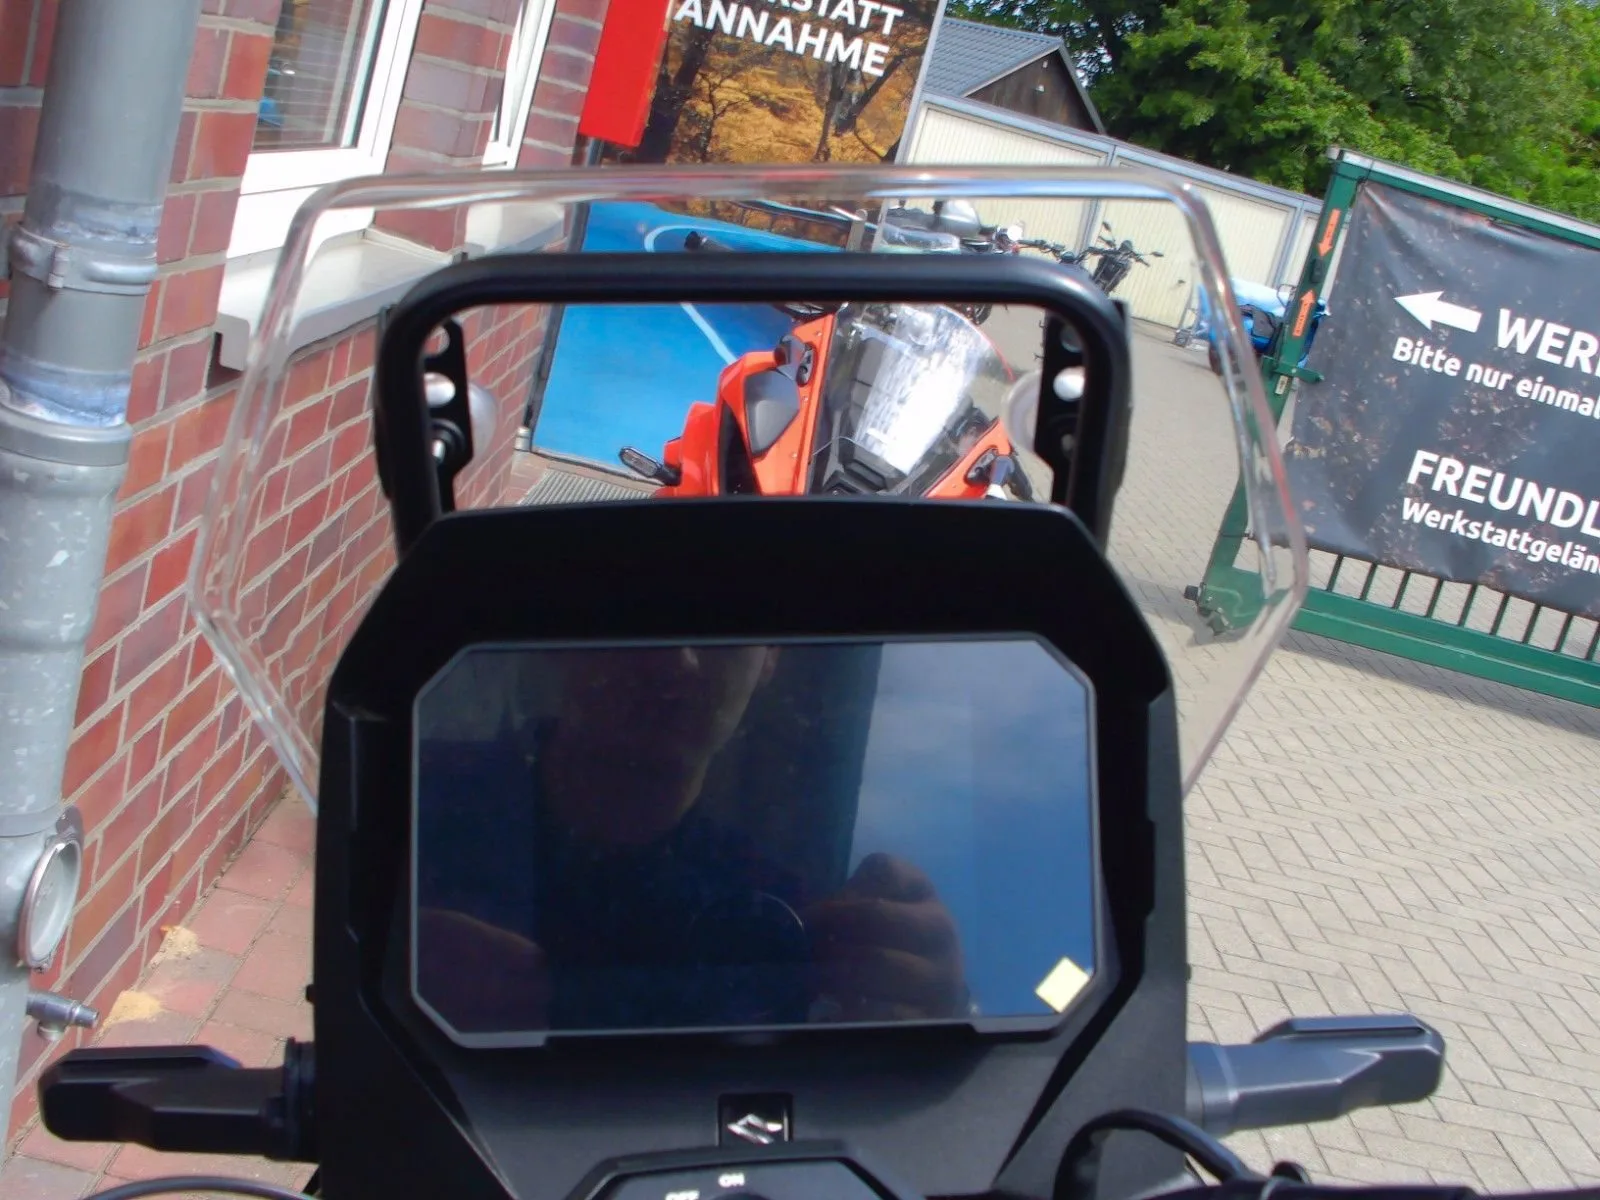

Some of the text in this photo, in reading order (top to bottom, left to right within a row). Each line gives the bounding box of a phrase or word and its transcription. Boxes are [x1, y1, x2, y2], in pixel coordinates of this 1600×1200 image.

[673, 0, 890, 77] ANNAHME
[1392, 337, 1461, 377] Bitte
[1466, 363, 1513, 391] nur
[1497, 308, 1600, 377] WER
[1406, 450, 1600, 538] FREUNDL
[1401, 498, 1600, 576] Werkstattgelän
